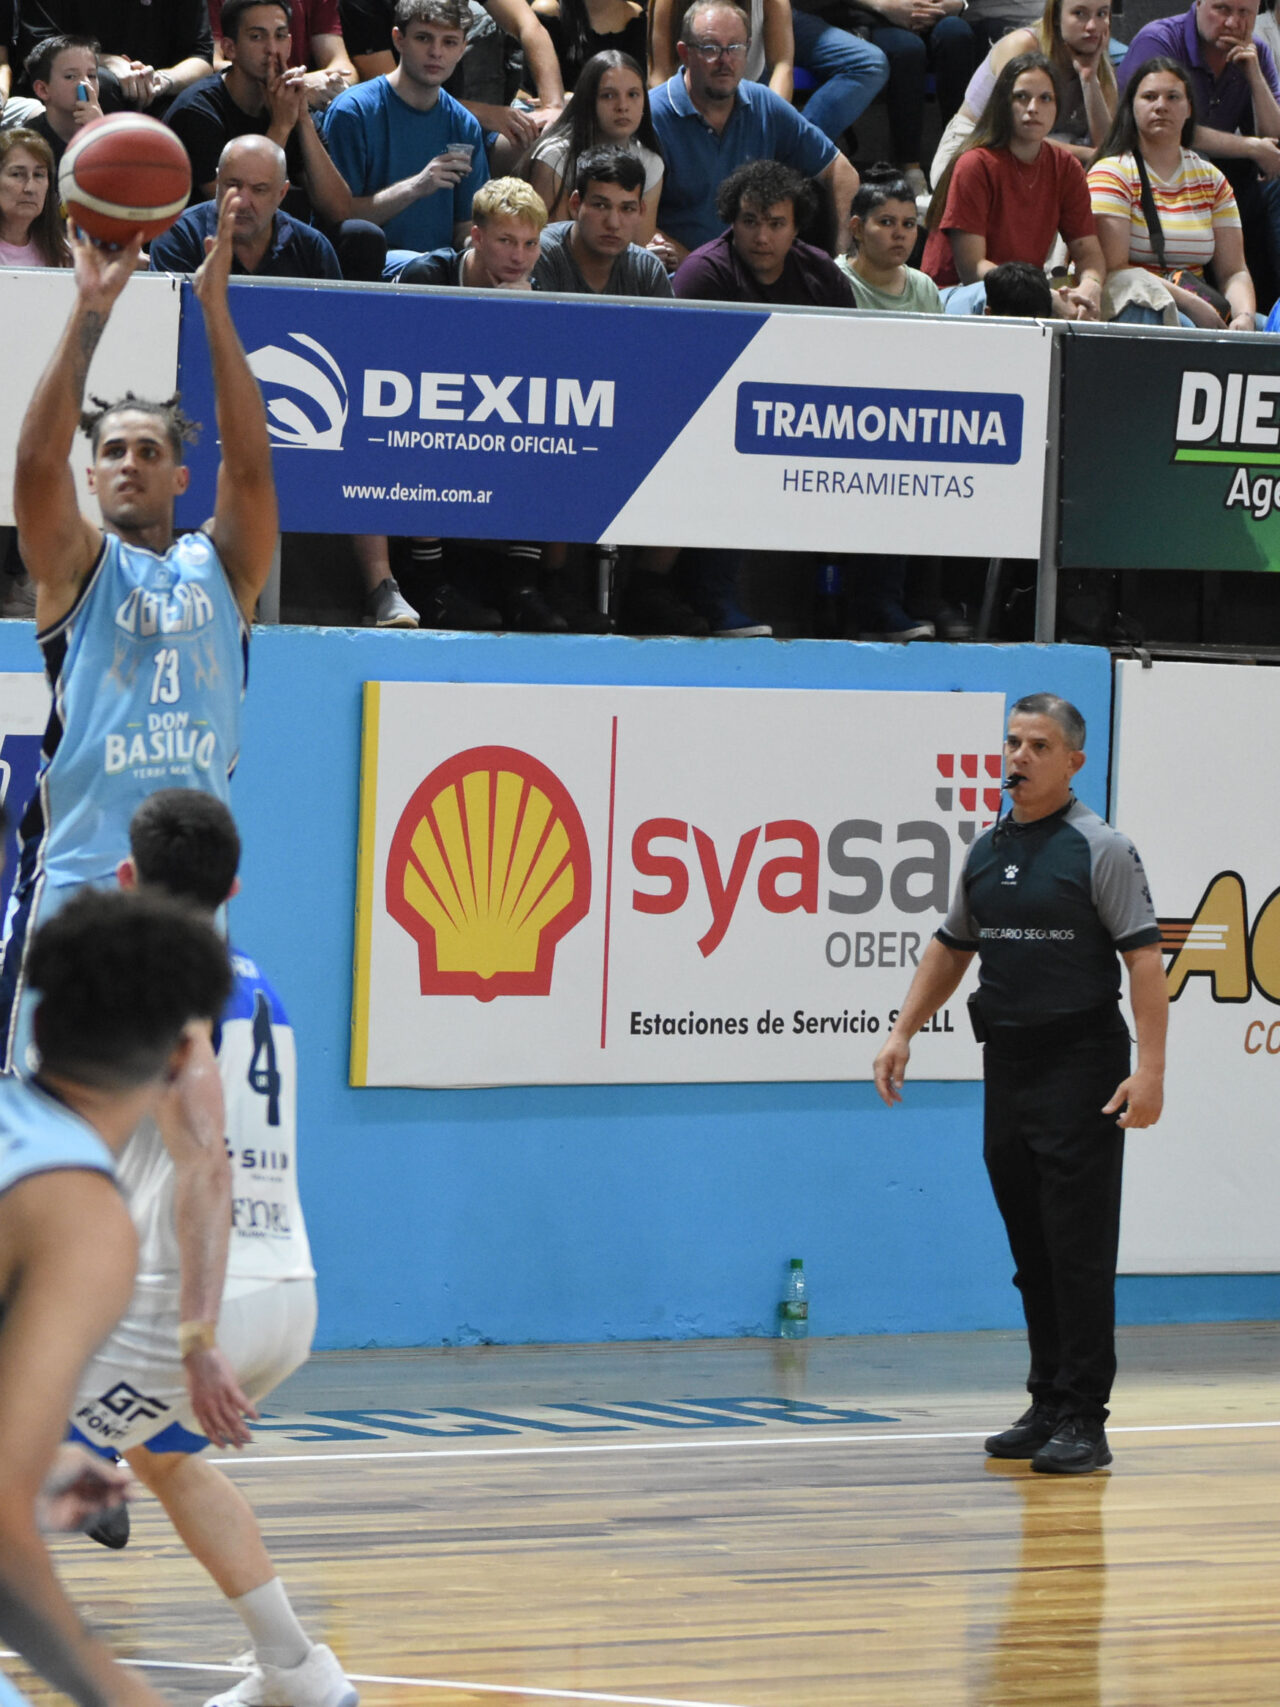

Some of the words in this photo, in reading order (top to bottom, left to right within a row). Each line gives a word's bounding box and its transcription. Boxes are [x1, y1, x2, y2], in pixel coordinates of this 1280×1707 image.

[362, 369, 616, 428] DEXIM
[752, 400, 1007, 446] TRAMONTINA
[387, 430, 506, 452] IMPORTADOR
[510, 435, 578, 455] OFICIAL
[342, 482, 493, 504] www.dexim.com.ar
[782, 468, 975, 499] HERRAMIENTAS
[150, 648, 181, 705] 13
[147, 711, 190, 732] DON
[825, 931, 938, 968] OBER
[1023, 928, 1075, 941] SEGUROS
[630, 1011, 749, 1035] Estaciones
[756, 1009, 785, 1035] de
[792, 1009, 880, 1034] Servicio
[887, 1009, 954, 1033] SLL
[247, 988, 281, 1126] 4
